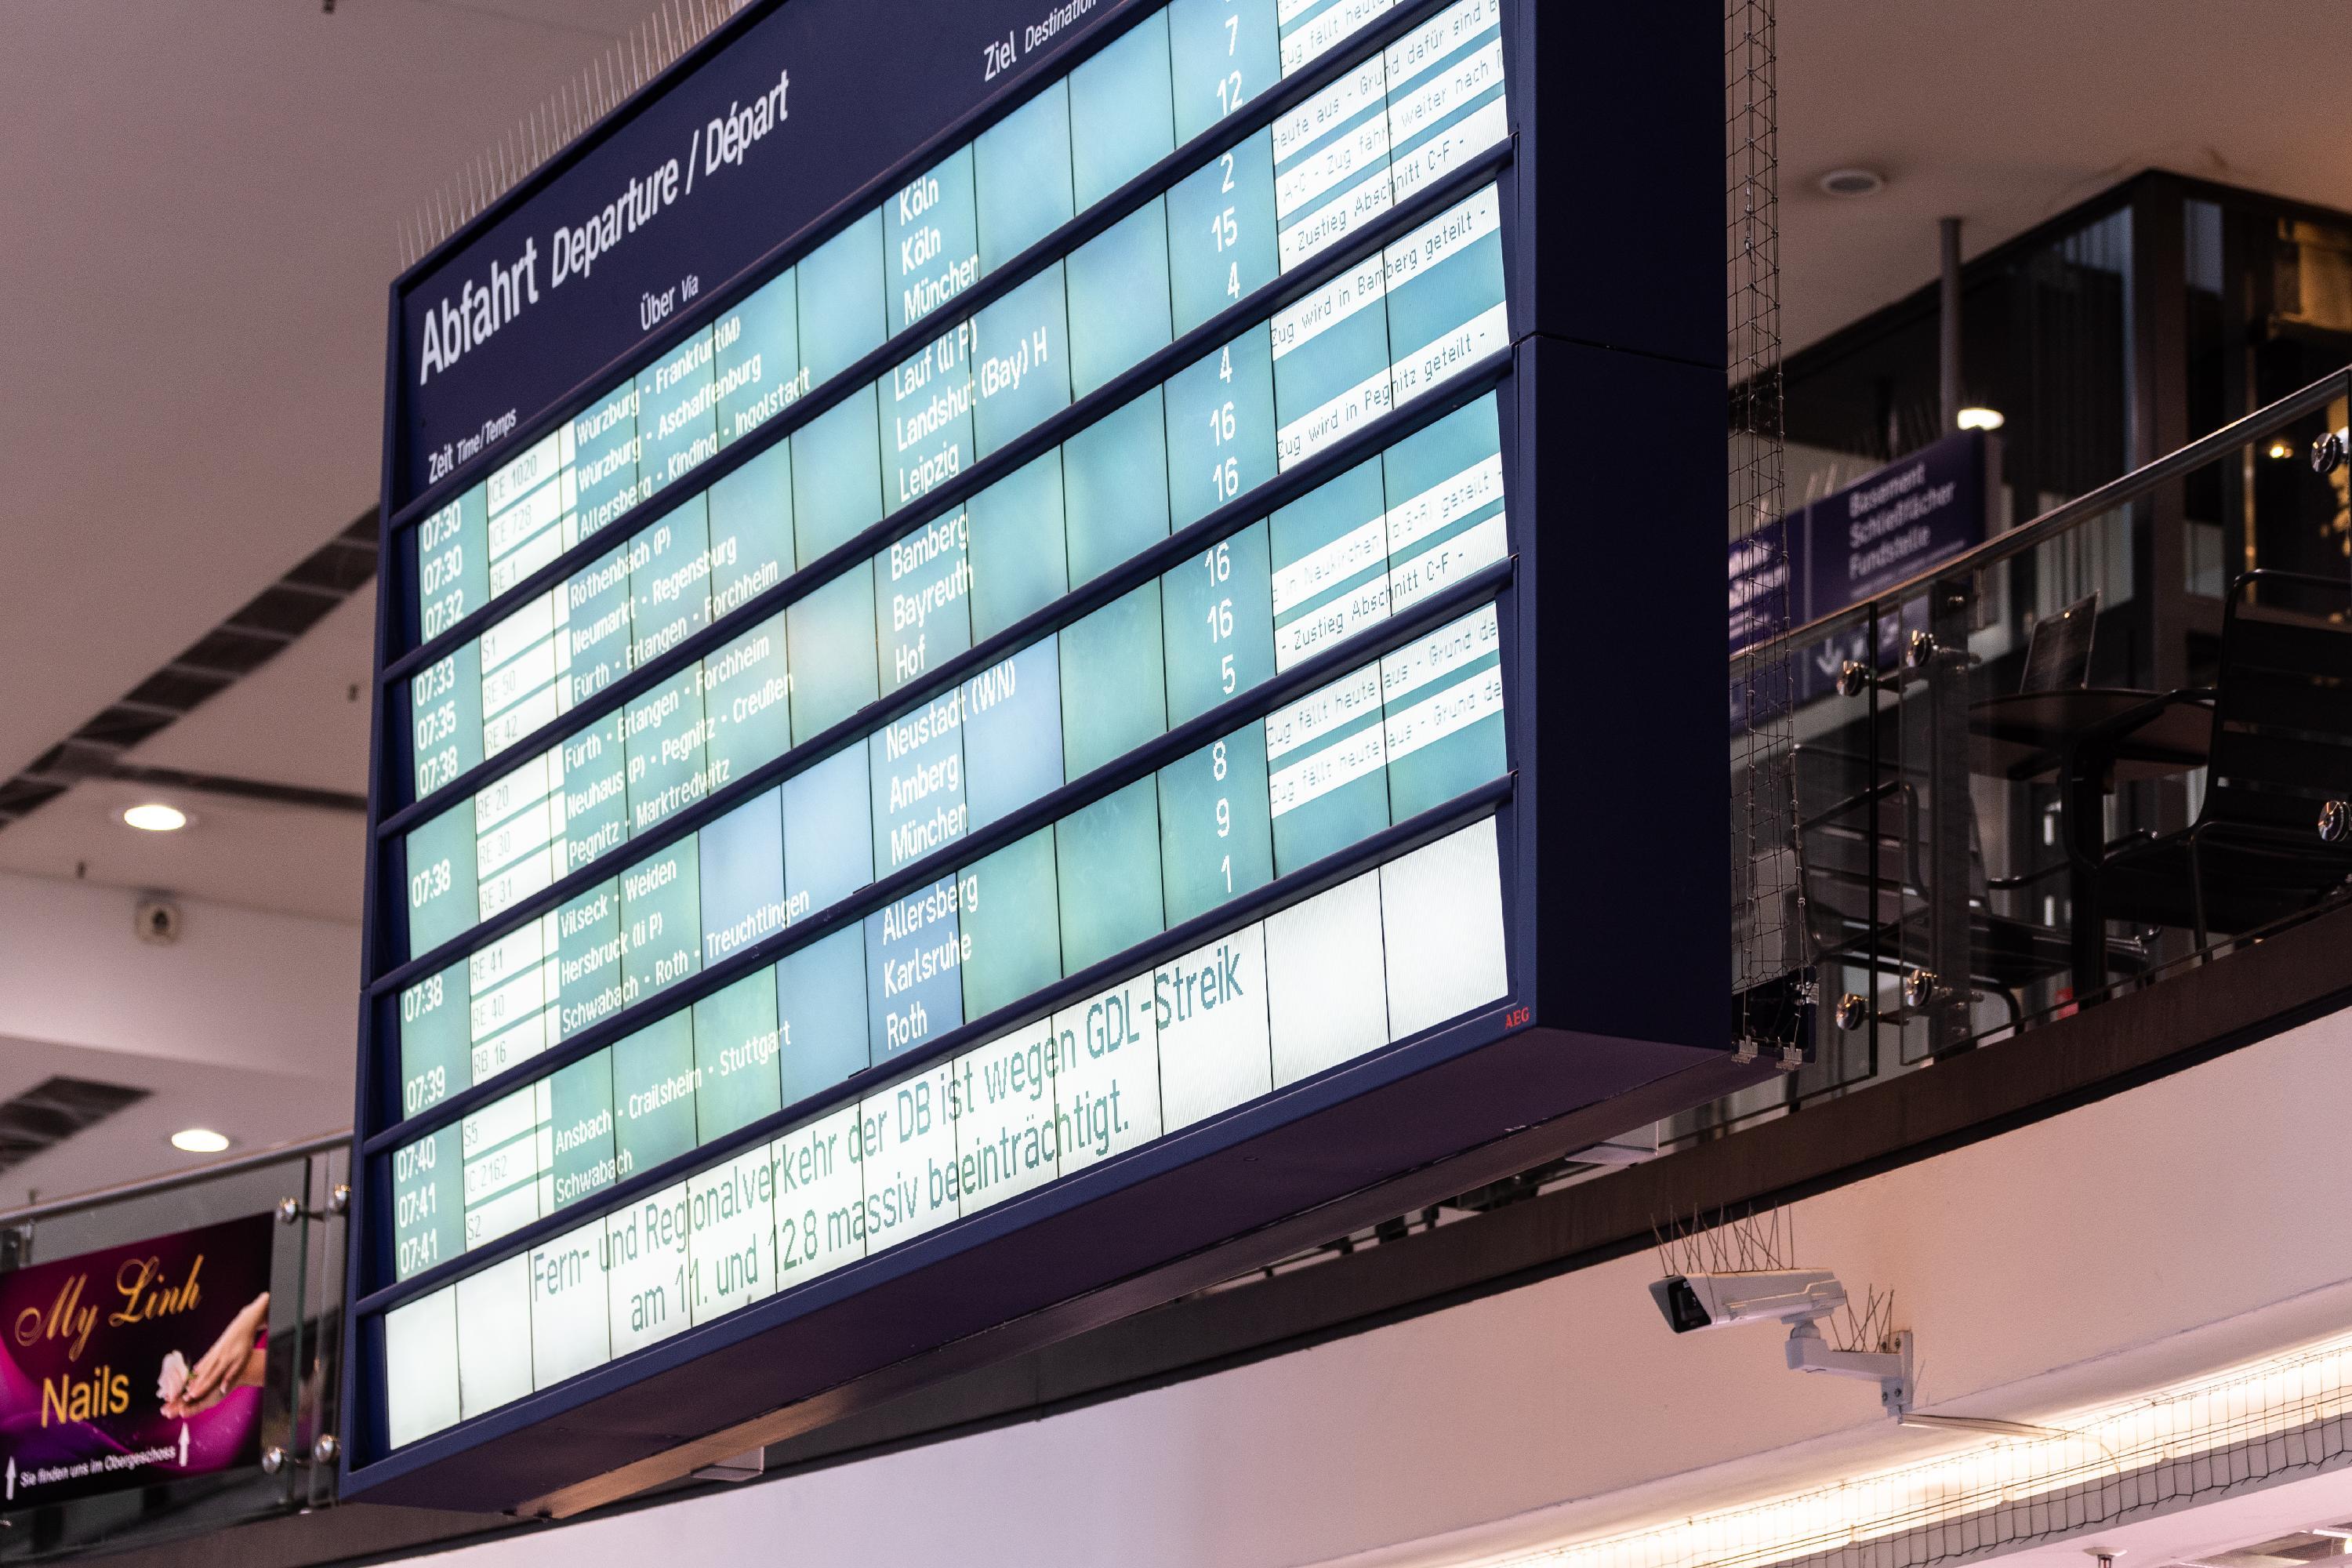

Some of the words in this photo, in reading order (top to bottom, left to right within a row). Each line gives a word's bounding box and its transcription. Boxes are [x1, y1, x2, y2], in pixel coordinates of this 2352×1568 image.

[984, 31, 1017, 82] Ziel
[1225, 14, 1238, 56] 7
[1216, 70, 1243, 116] 12
[1220, 153, 1234, 194] 2
[419, 237, 539, 386] Abfahrt
[552, 158, 679, 289] Departure
[706, 70, 789, 176] Départ
[899, 176, 938, 226] Köln
[1298, 211, 1346, 251] Zustieg
[1355, 158, 1420, 216] Abschnitt
[902, 226, 941, 275] Köln
[1211, 206, 1238, 252] 15
[641, 287, 675, 330] Über
[682, 274, 699, 303] Via
[904, 253, 979, 325] München
[1227, 262, 1240, 299] 4
[1271, 321, 1294, 347] Zug
[1339, 287, 1350, 307] in
[1425, 212, 1472, 256] geteilt
[894, 347, 931, 401] Lauf
[1219, 346, 1232, 383] 4
[1345, 401, 1357, 419] in
[1425, 336, 1472, 377] geteilt
[577, 390, 640, 446] Würzburg
[897, 374, 976, 452] Landshut
[982, 339, 1029, 398] (Bay)
[429, 444, 453, 484] Zeit
[457, 408, 516, 465] Time/Temps
[579, 436, 641, 492] Würzburg
[658, 354, 761, 441] Aschaffenburg
[1210, 401, 1236, 446] 16
[580, 476, 652, 539] Allersberg
[668, 433, 718, 481] Kinding
[735, 367, 810, 437] Ingolstadt
[900, 441, 959, 503] Leipzig
[1213, 456, 1238, 502] 16
[423, 502, 461, 552] 07:30
[891, 513, 969, 582] Bamberg
[424, 544, 462, 596] 07:30
[571, 541, 649, 610] Röthenbach
[654, 525, 671, 557] (P)
[1204, 543, 1229, 587] 16
[426, 589, 463, 641] 07:32
[572, 596, 636, 656] Neumarkt
[652, 536, 737, 605] Regensburg
[893, 557, 974, 632] Bayreuth
[1207, 598, 1233, 643] 16
[1294, 612, 1343, 651] Zustieg
[1352, 570, 1418, 621] Abschnitt
[574, 662, 609, 702] Fürth
[626, 616, 688, 670] Erlangen
[705, 561, 779, 623] Forchheim
[416, 656, 455, 706] 07:33
[895, 634, 925, 684] Hof
[1221, 654, 1236, 694] 5
[417, 701, 456, 750] 07:35
[565, 734, 601, 773] Fürth
[617, 690, 678, 743] Erlangen
[696, 636, 769, 696] Forchheim
[886, 686, 967, 762] Neustadt
[971, 659, 1015, 715] (WN)
[419, 746, 458, 795] 07:38
[567, 770, 624, 820] Neuhaus
[629, 754, 646, 785] (P)
[662, 715, 716, 765] Pegnitz
[733, 673, 794, 724] Creußen
[1213, 741, 1227, 782] 8
[890, 753, 959, 814] Amberg
[569, 821, 619, 867] Pegnitz
[636, 758, 730, 829] Marktredwitz
[891, 802, 968, 866] München
[1216, 797, 1229, 838] 9
[412, 858, 451, 908] 07:38
[561, 894, 608, 938] Vilseck
[626, 859, 677, 902] Weiden
[1221, 855, 1232, 893] 1
[883, 874, 978, 946] Allersberg
[561, 931, 628, 985] Hersbruck
[563, 975, 639, 1033] Schwabach
[656, 949, 688, 985] Roth
[706, 890, 810, 959] Treuchtlingen
[884, 931, 972, 998] Karlsruhe
[405, 975, 443, 1022] 07:38
[1505, 1007, 1530, 1029] AEG
[886, 1001, 927, 1051] Roth
[407, 1065, 445, 1112] 07:39
[555, 1109, 612, 1156] Ansbach
[629, 1066, 702, 1120] Crailsheim
[720, 1021, 791, 1076] Stuttgart
[534, 1249, 589, 1302] Fern-
[599, 1211, 637, 1272] und
[645, 1131, 837, 1253] Regionalverkehr
[848, 1110, 887, 1163] der
[898, 1081, 931, 1143] DB
[941, 1062, 974, 1125] ist
[984, 1029, 1076, 1104] wegen
[1087, 945, 1243, 1059] GDL-Streik
[397, 1135, 436, 1183] 07:40
[556, 1149, 633, 1203] Schwabach
[399, 1183, 436, 1228] 07:41
[631, 1286, 665, 1331] am
[675, 1258, 707, 1313] 11.
[717, 1233, 757, 1296] und
[768, 1209, 818, 1274] 12.8
[828, 1171, 917, 1252] massiv
[928, 1079, 1128, 1210] beeinträchtigt.
[400, 1229, 437, 1274] 07:41
[15, 1272, 98, 1362] My
[108, 1254, 203, 1327] Linh
[41, 1365, 129, 1428] Nails
[20, 1471, 36, 1487] Sie
[38, 1466, 68, 1484] finden
[70, 1463, 89, 1478] uns
[90, 1458, 103, 1474] im
